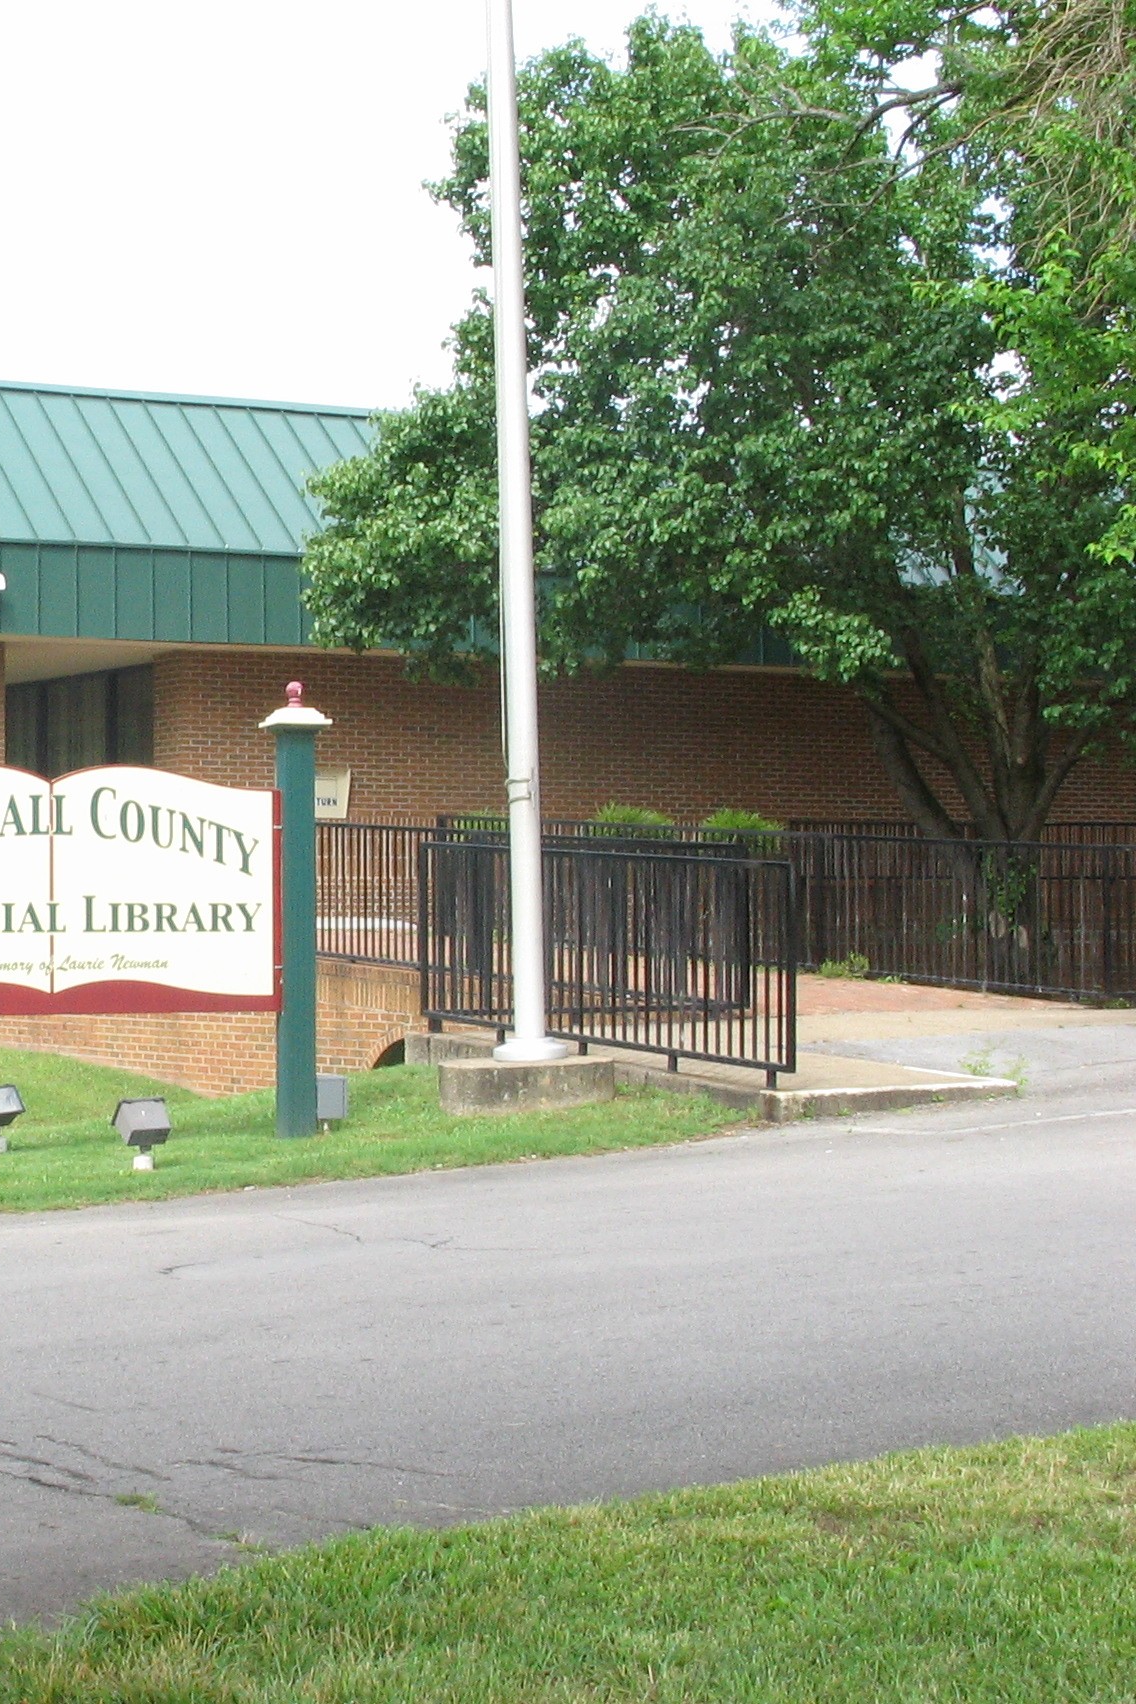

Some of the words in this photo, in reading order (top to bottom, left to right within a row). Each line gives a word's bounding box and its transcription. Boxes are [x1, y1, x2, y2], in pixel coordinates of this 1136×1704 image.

[316, 797, 338, 806] TURN
[90, 786, 259, 876] COUNTY
[82, 895, 262, 933] LIBRARY
[38, 954, 54, 976] of
[56, 955, 104, 971] Laurie
[110, 953, 169, 970] Newman
